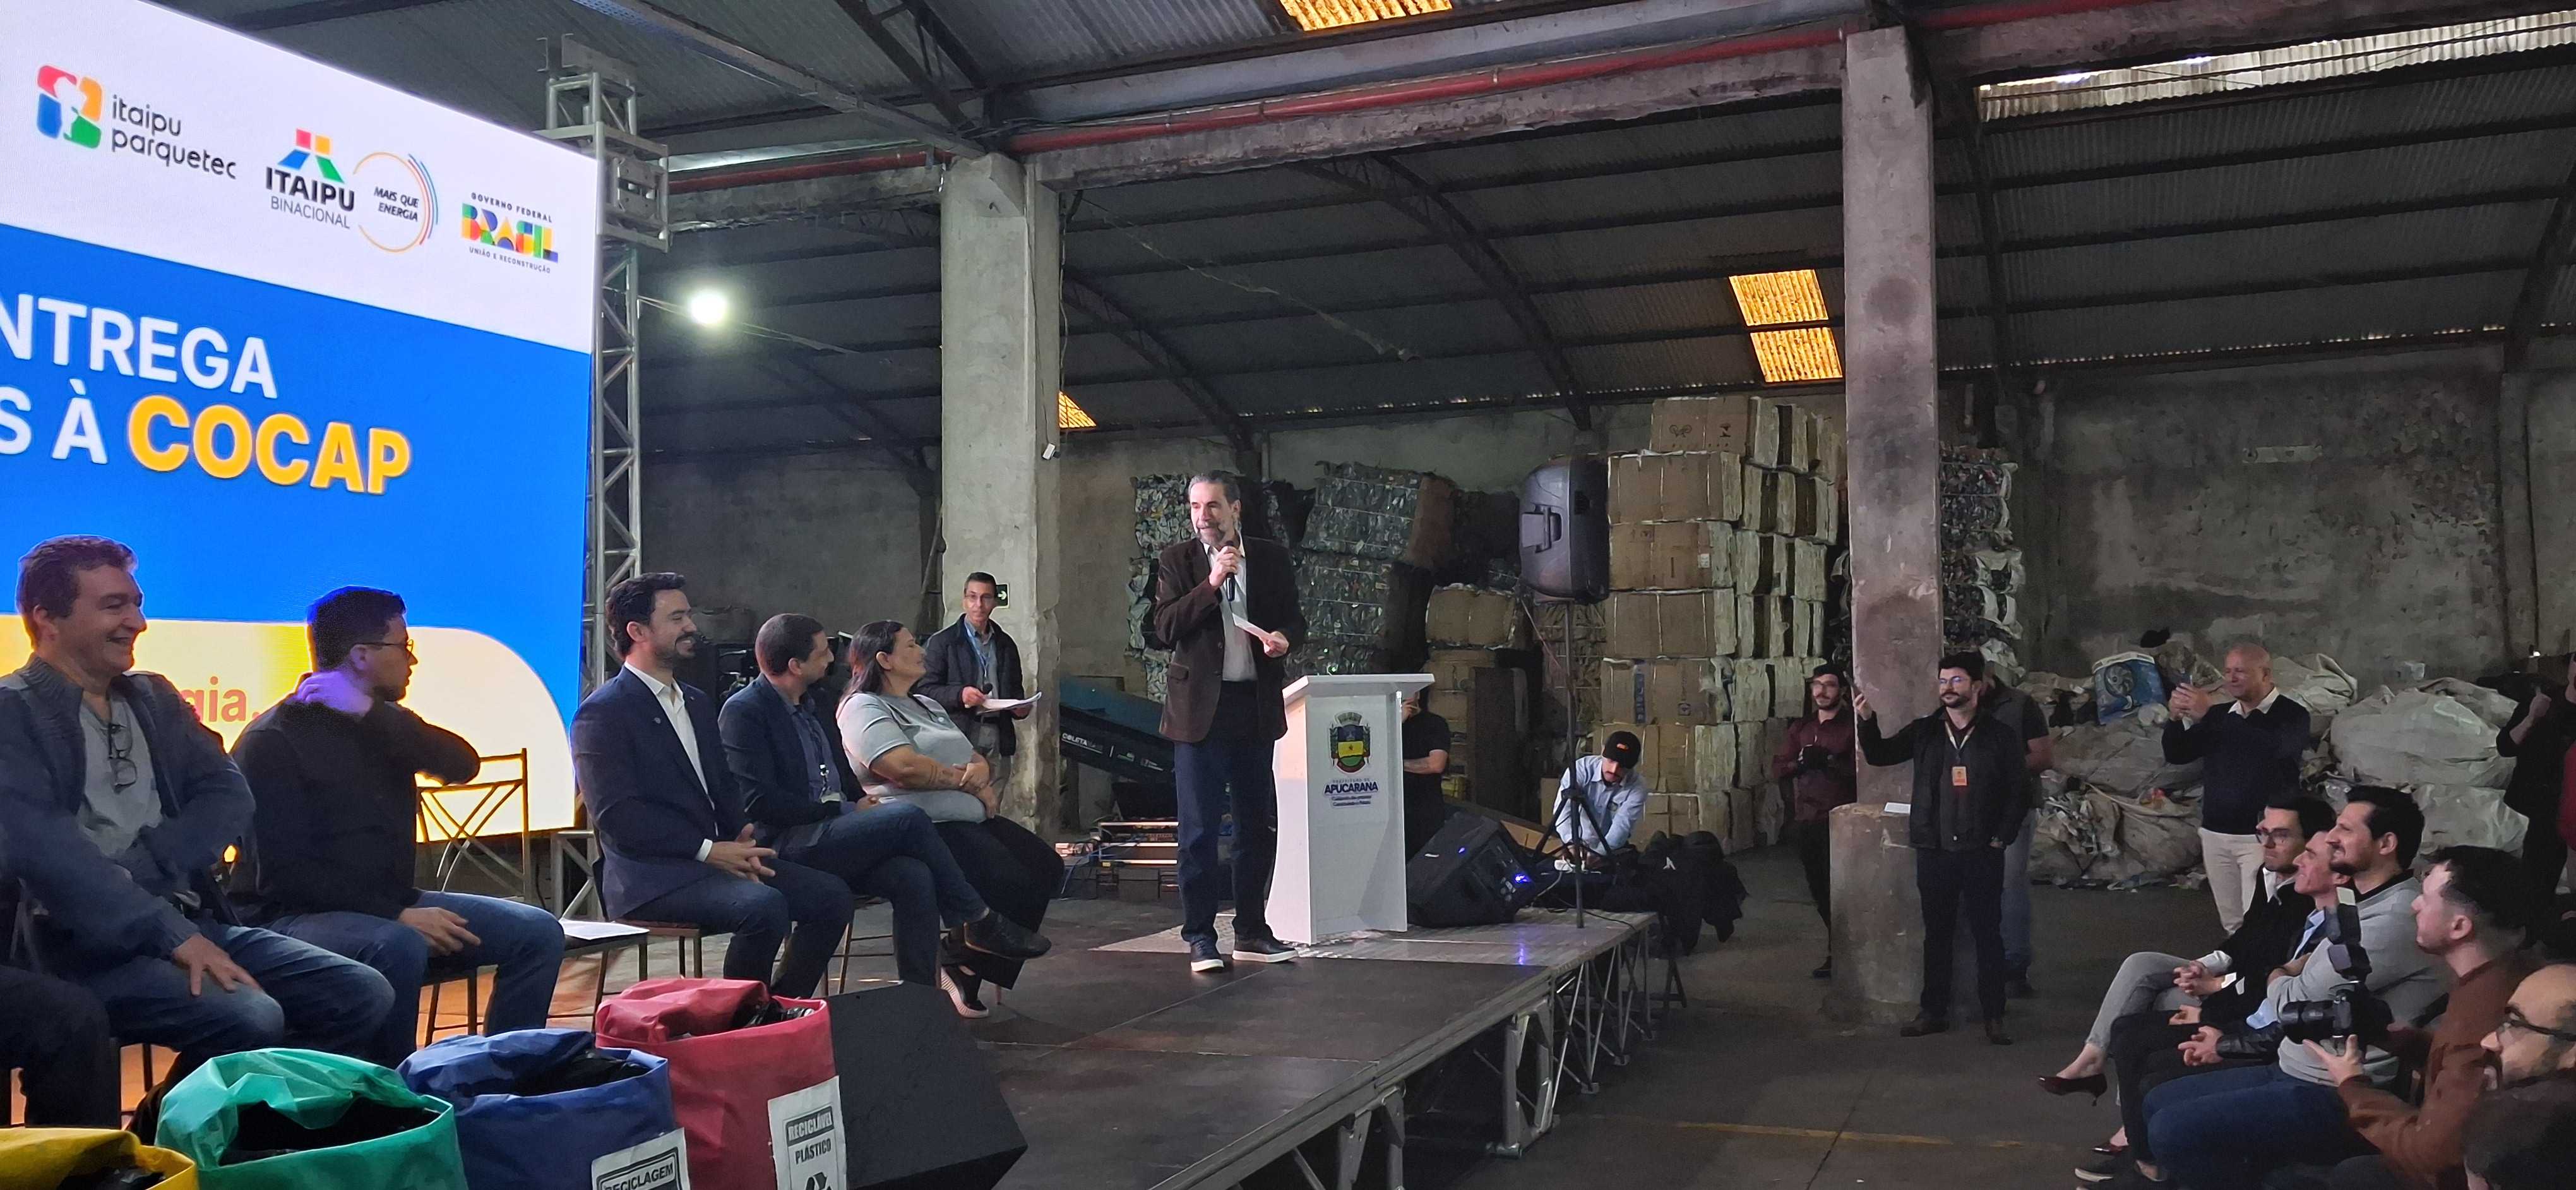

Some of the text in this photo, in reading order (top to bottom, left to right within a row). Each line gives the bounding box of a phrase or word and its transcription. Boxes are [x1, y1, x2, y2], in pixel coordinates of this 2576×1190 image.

[112, 95, 181, 136] itaipu
[112, 128, 236, 180] parquetec
[266, 166, 355, 212] ITAIPU
[374, 186, 419, 208] MAIS QUE
[271, 196, 350, 229] BINACIONAL
[378, 201, 418, 222] ENERGIA
[471, 192, 552, 223] GOVERNO FEDERAL
[462, 203, 559, 263] BRASIL
[469, 246, 491, 258] UNIÃO
[499, 255, 551, 273] RECONSTRUÇÃO
[0, 293, 278, 399] NTREGA
[0, 378, 411, 495] S À COCAP
[1324, 781, 1379, 794] APUCARANA
[796, 1138, 832, 1165] PLÁSTICO
